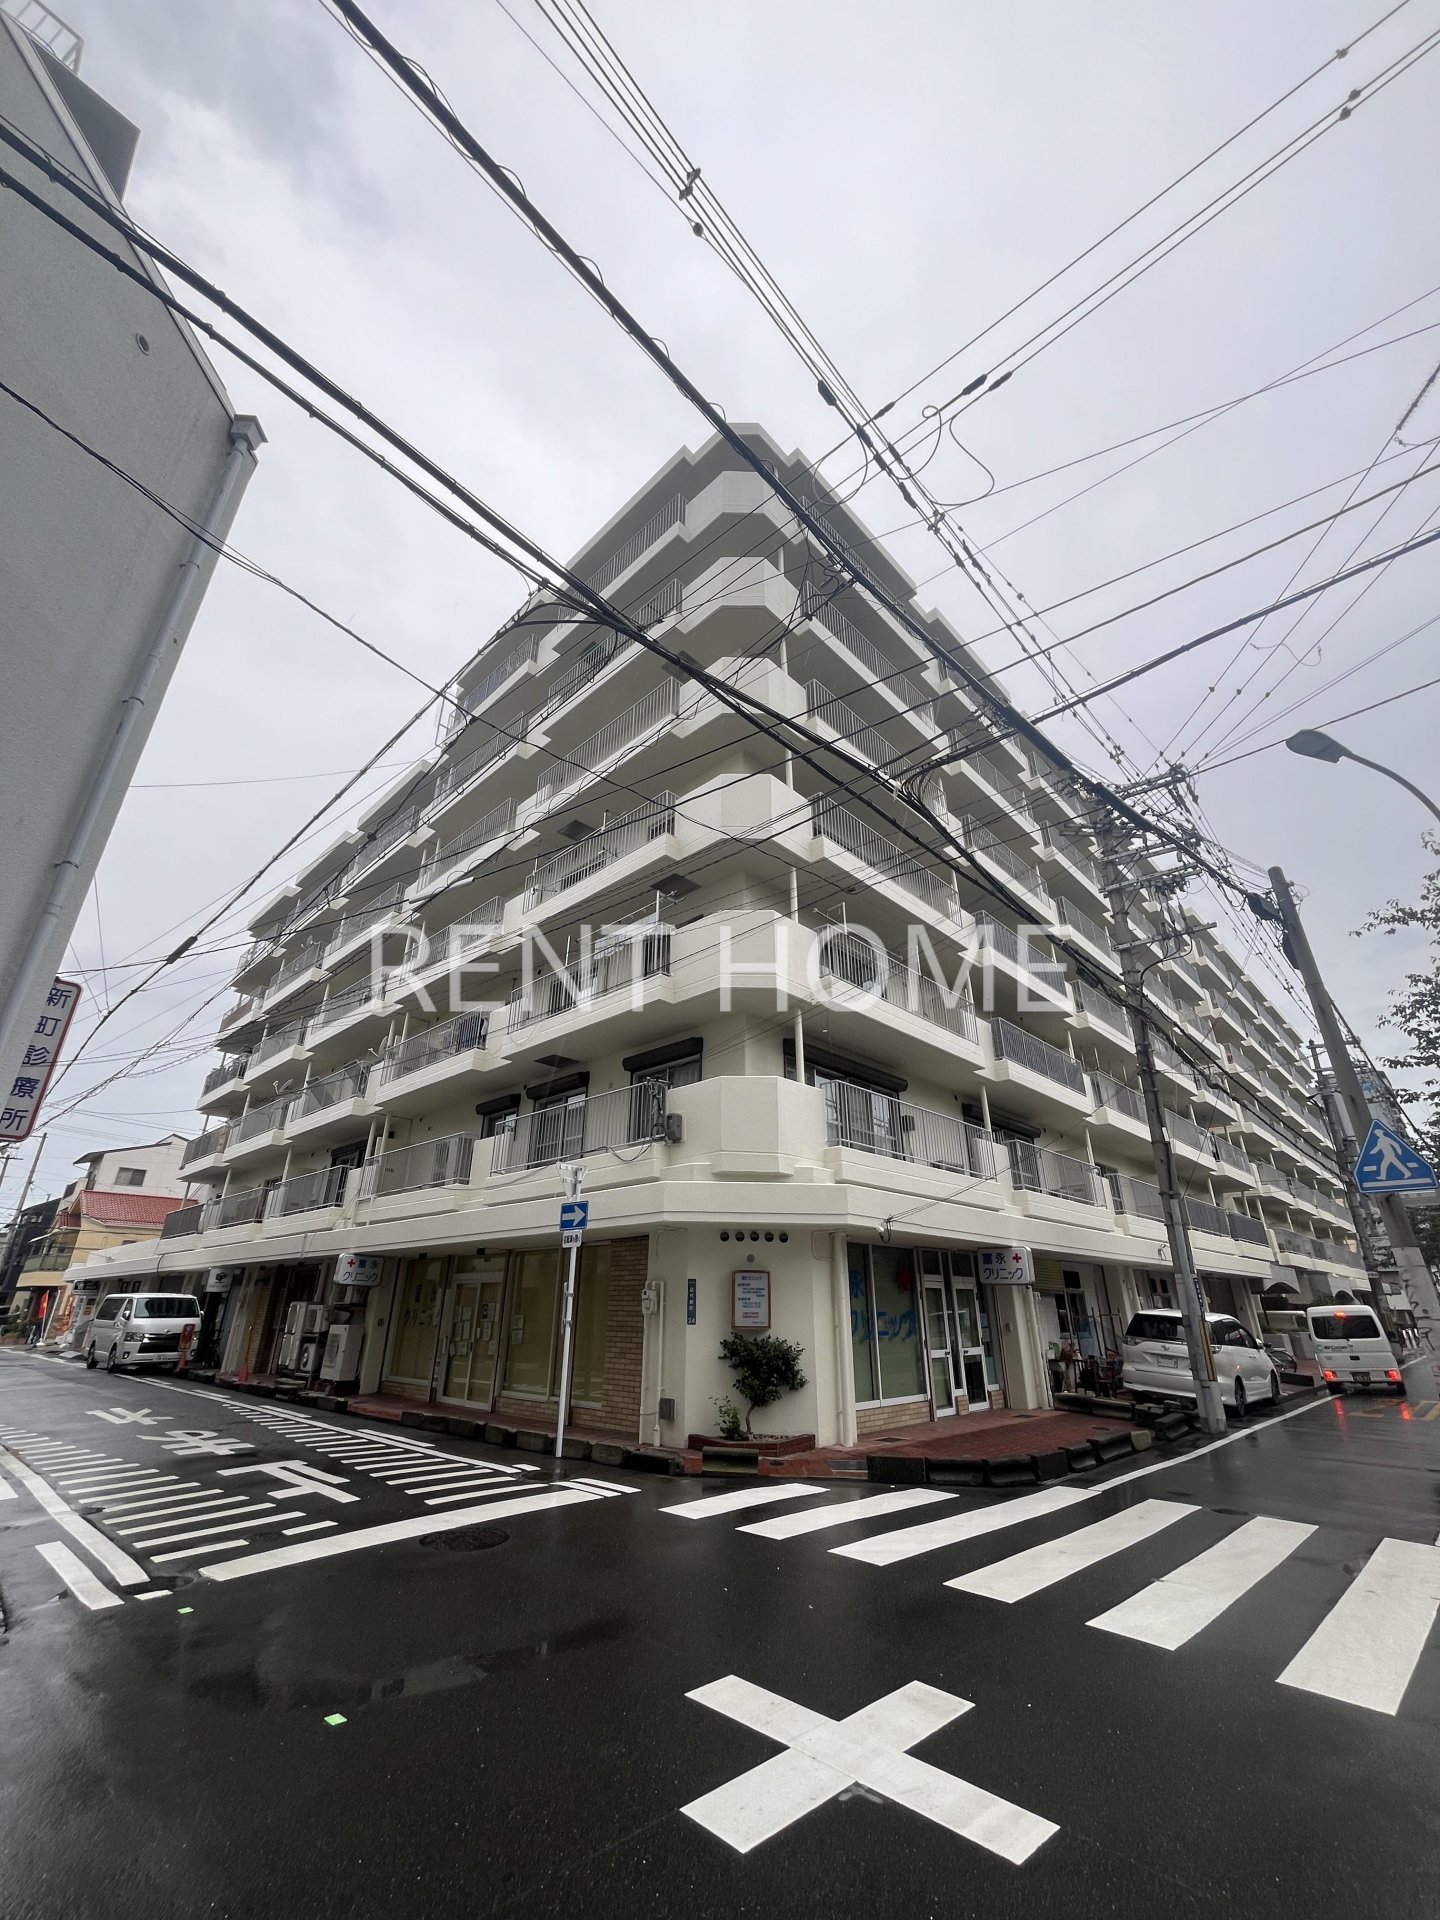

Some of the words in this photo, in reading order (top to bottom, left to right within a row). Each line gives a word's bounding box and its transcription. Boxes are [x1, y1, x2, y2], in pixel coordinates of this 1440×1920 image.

[0, 986, 73, 1131] 新町診療所
[342, 1271, 379, 1282] クリニック
[983, 1267, 1024, 1280] クリニック
